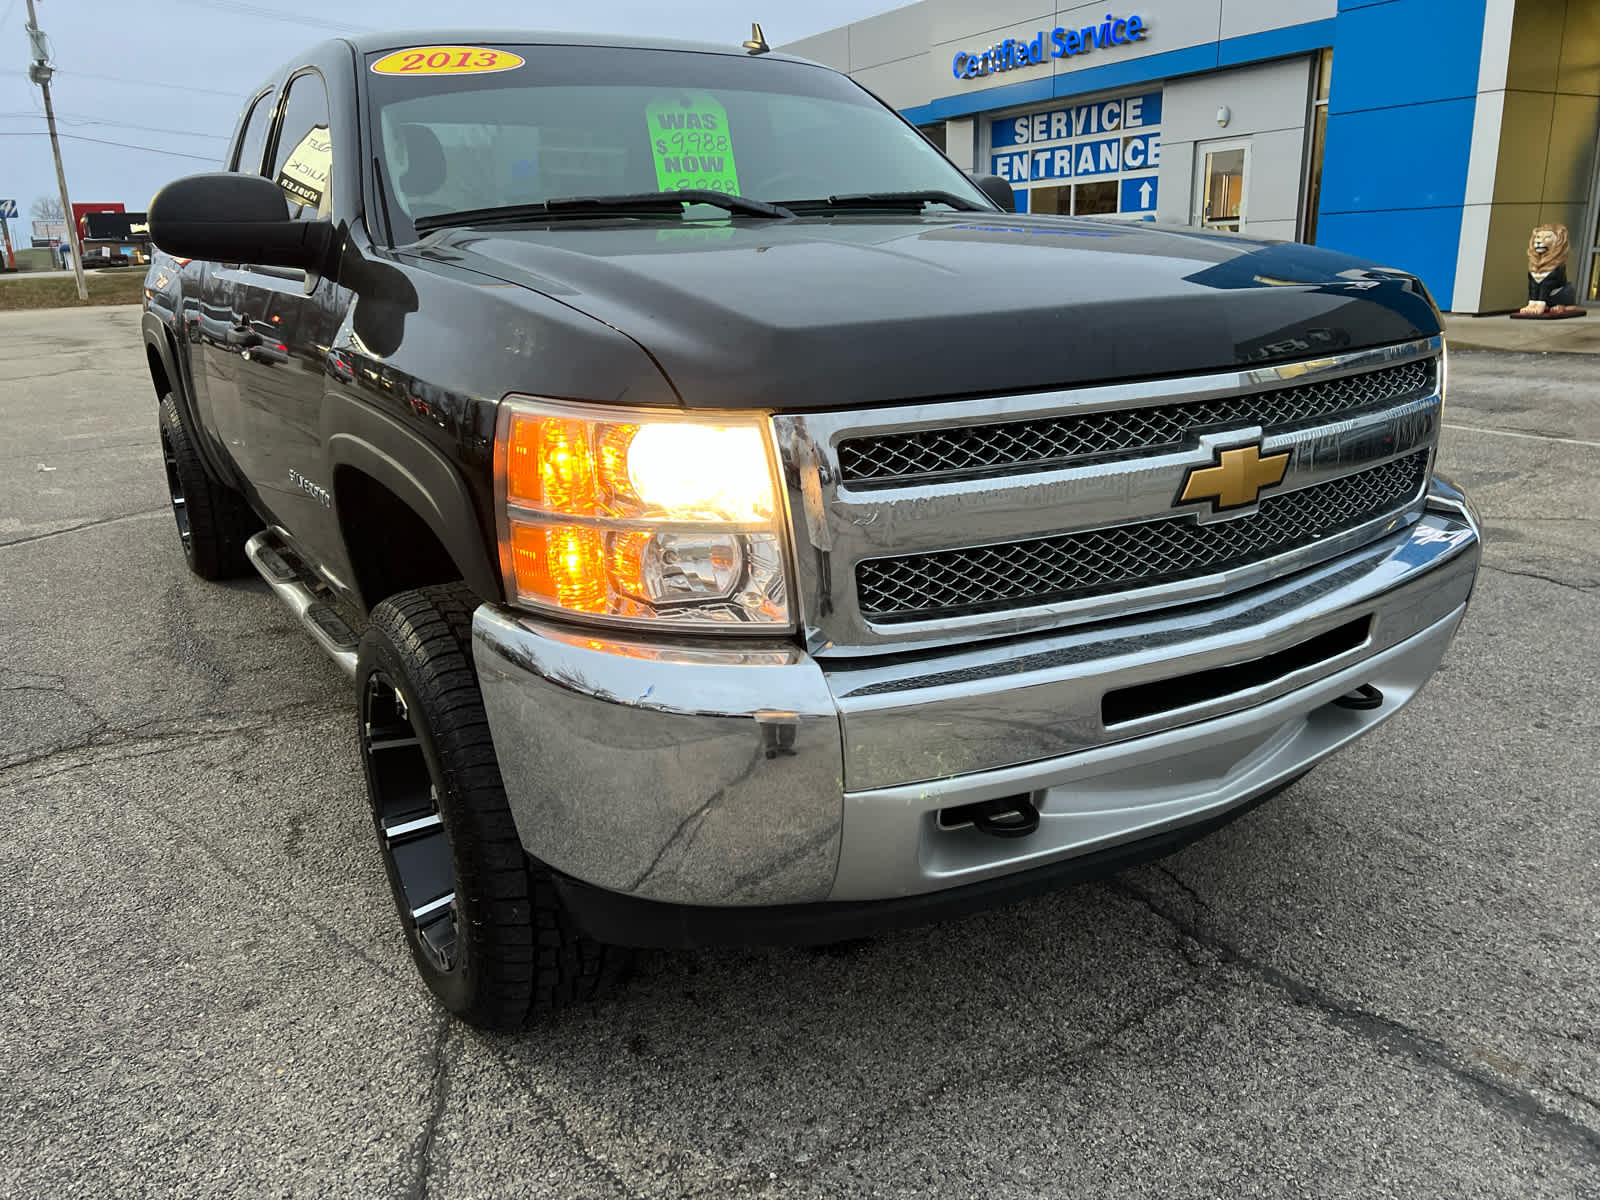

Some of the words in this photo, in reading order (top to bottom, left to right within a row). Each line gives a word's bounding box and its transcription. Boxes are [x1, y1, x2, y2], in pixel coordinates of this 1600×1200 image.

[400, 52, 498, 72] 2013
[953, 32, 1043, 79] Certified
[1051, 14, 1143, 58] Service
[657, 112, 717, 129] WAS
[1014, 98, 1143, 144] SERVICE
[663, 156, 724, 173] NOW
[996, 136, 1160, 181] ENTRANCE
